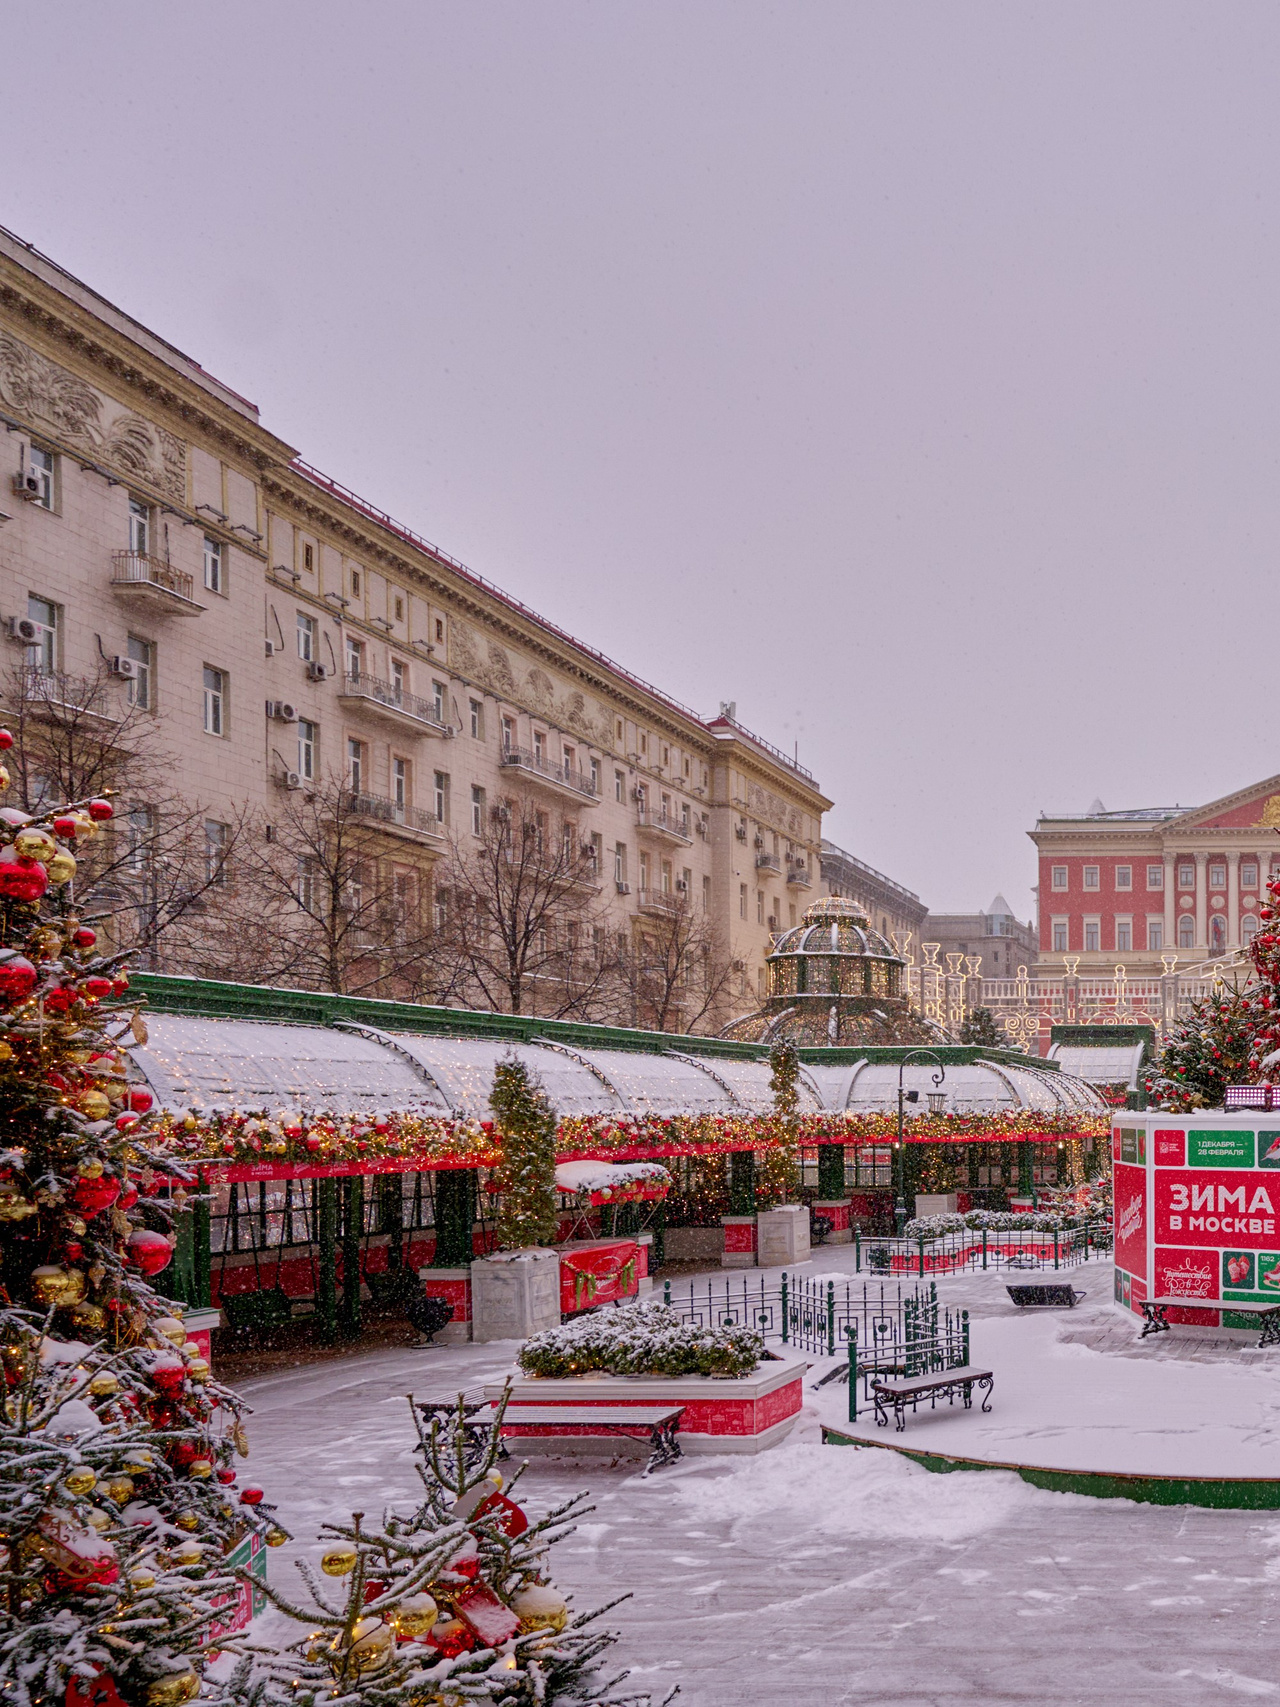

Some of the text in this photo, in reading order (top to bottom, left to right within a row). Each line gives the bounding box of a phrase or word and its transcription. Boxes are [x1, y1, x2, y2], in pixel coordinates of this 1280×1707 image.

[1169, 1183, 1275, 1214] ЗИМА
[1169, 1215, 1276, 1235] В МОСКВЕ
